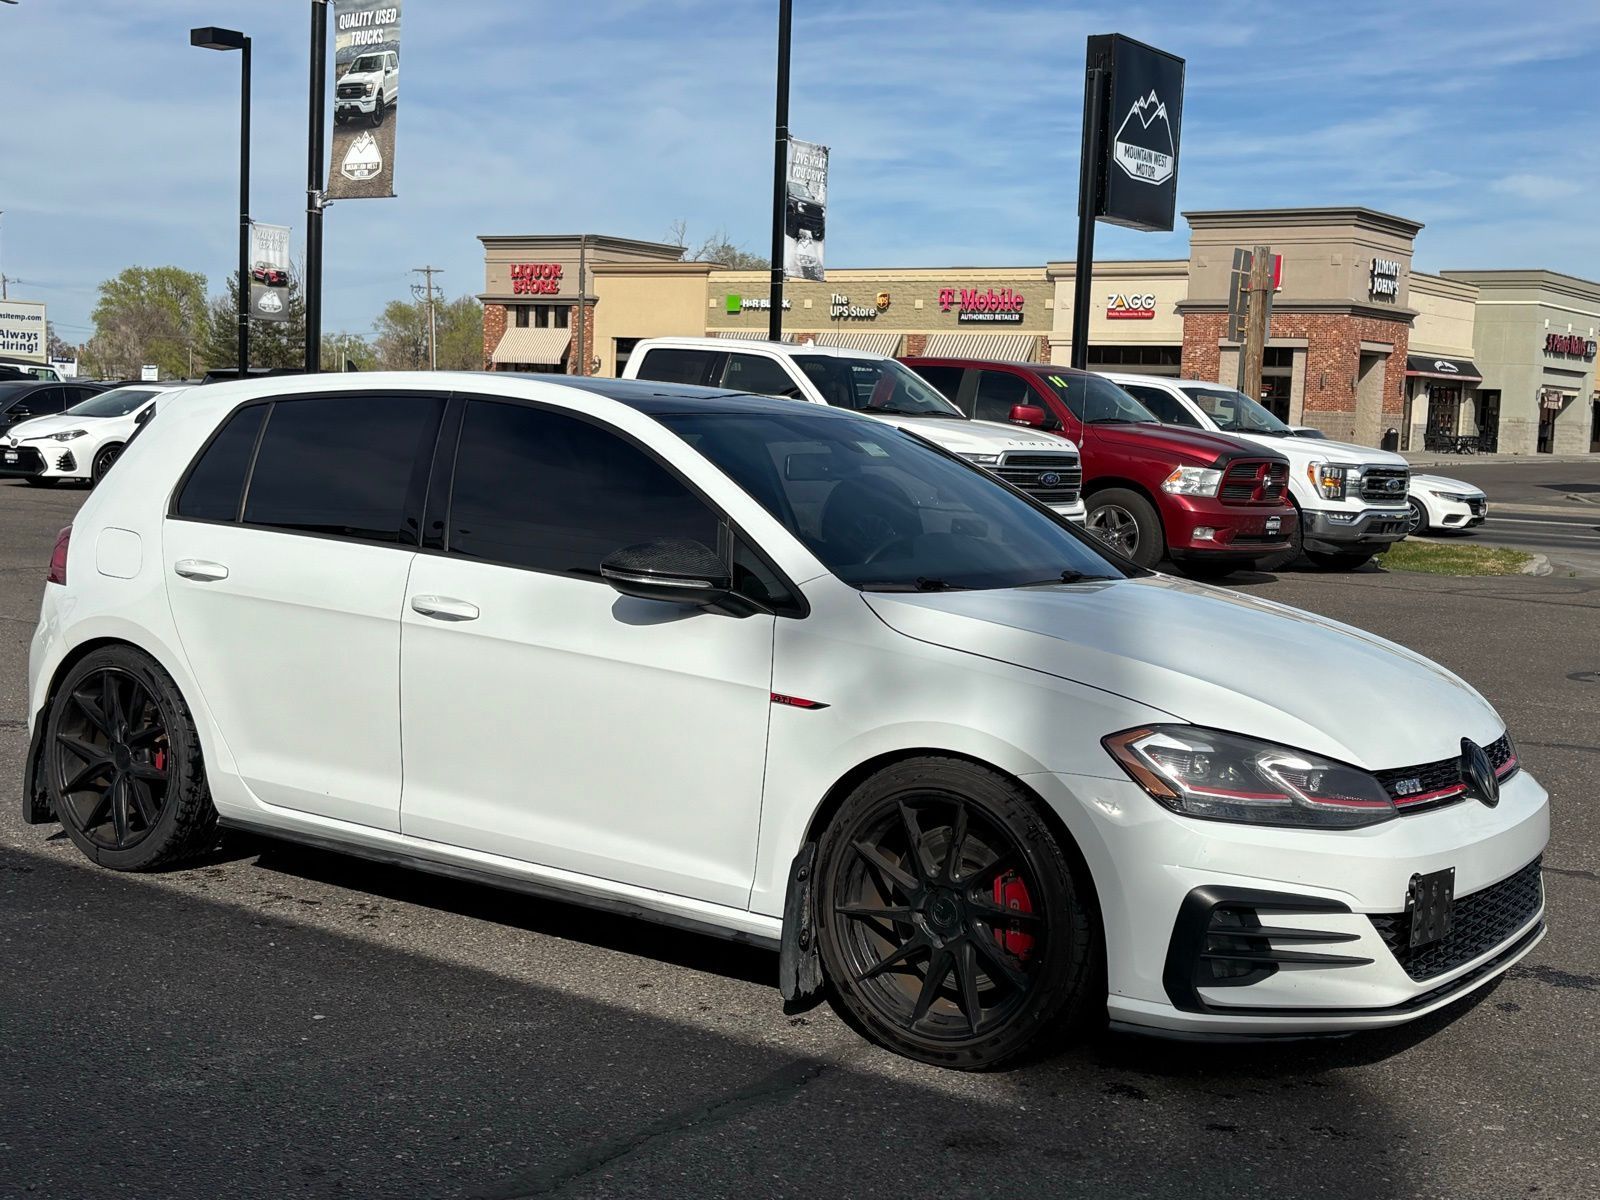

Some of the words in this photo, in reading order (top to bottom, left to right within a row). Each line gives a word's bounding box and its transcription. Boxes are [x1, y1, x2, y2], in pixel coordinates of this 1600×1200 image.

[339, 11, 373, 30] QUALITY
[375, 8, 397, 25] USED
[351, 28, 384, 46] TRUCKS
[809, 154, 826, 169] WHAT
[1124, 144, 1153, 164] MOUNTAIN
[1153, 153, 1168, 169] WEST
[793, 165, 806, 179] YOU
[806, 168, 826, 183] DRIVE
[1135, 161, 1156, 178] MOTOR
[511, 264, 563, 281] LIQUOR
[1373, 258, 1402, 277] JIMMY
[513, 279, 560, 295] STORE
[1372, 276, 1400, 296] JOHN'S
[742, 299, 760, 308] H&R
[760, 299, 791, 308] BLK
[831, 293, 849, 304] The
[1107, 293, 1157, 310] ZAGG
[830, 305, 850, 317] UPS
[850, 306, 877, 317] Store
[960, 313, 994, 321] AUTHORIZED
[995, 313, 1020, 321] RETAILER
[0, 329, 39, 343] Always
[0, 340, 39, 354] Hiring!
[1048, 375, 1069, 388] 11
[1395, 778, 1423, 796] GTI
